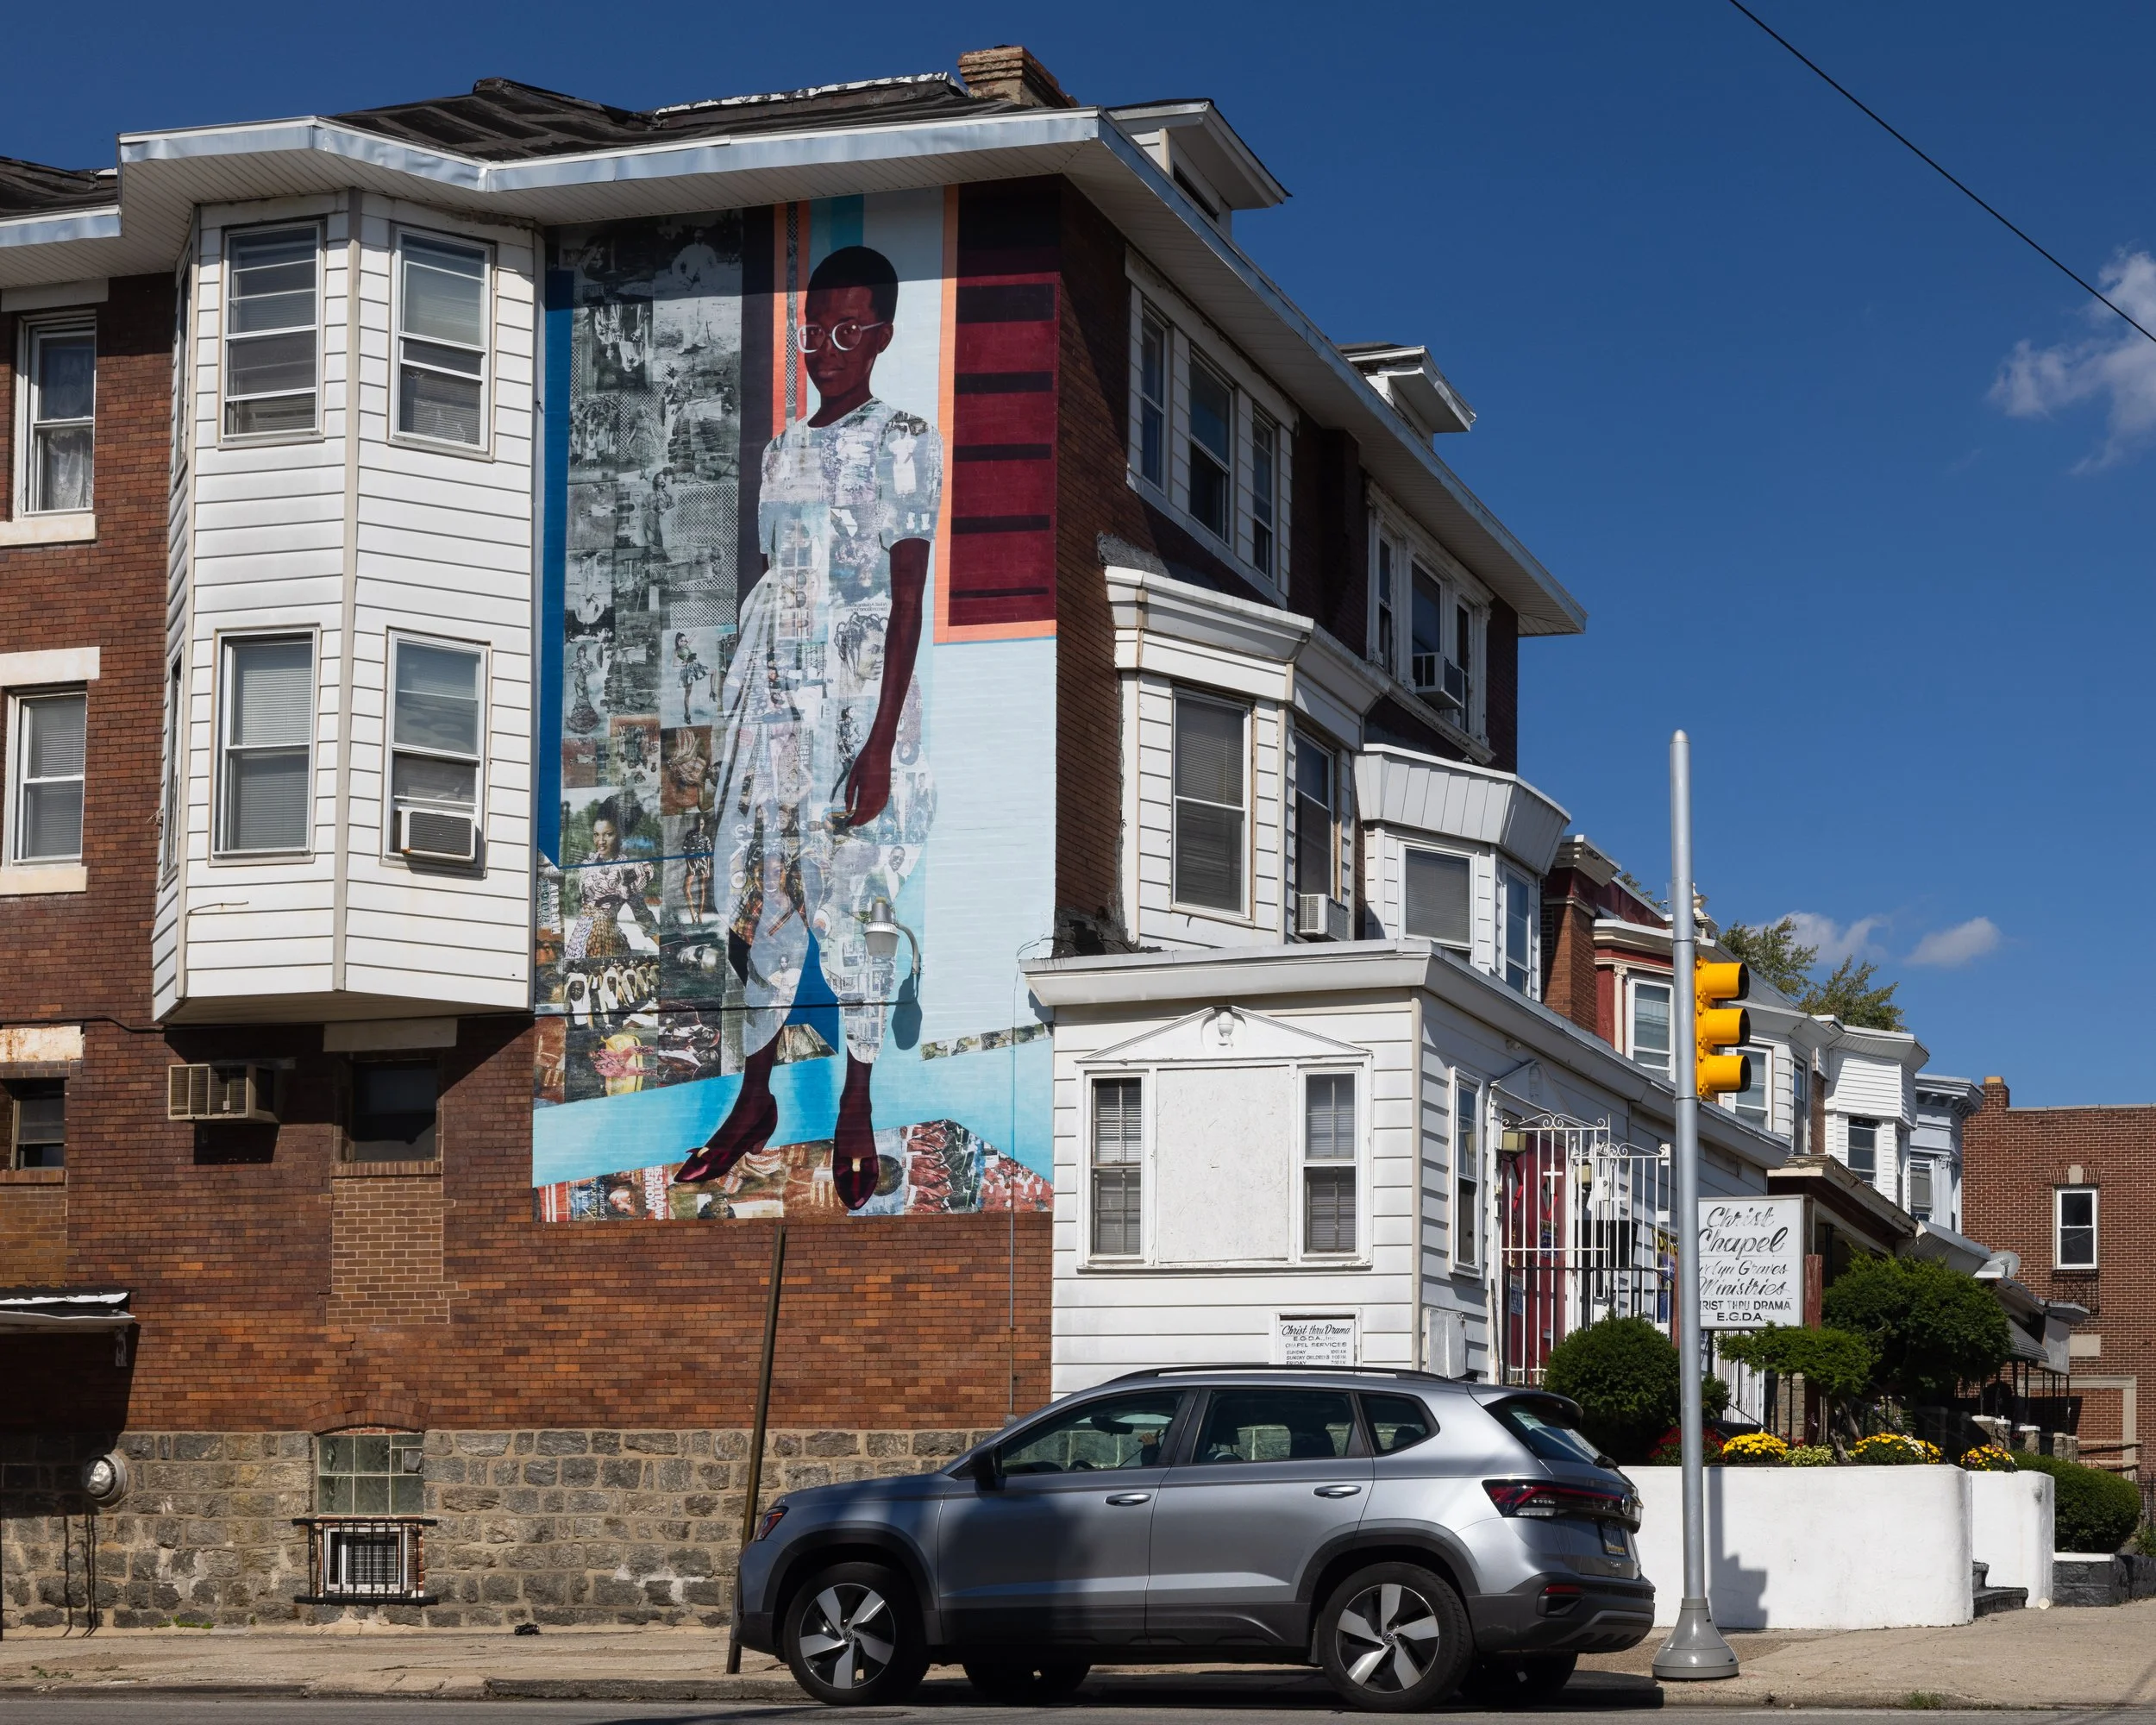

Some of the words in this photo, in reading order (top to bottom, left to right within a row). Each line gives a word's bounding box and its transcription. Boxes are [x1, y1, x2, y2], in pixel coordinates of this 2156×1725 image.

[1706, 1207, 1774, 1228] Christ
[1698, 1226, 1788, 1260] Chapel
[1739, 1260, 1790, 1275] Graves
[1699, 1276, 1791, 1295] Ministries
[1700, 1300, 1724, 1310] RIST
[1754, 1300, 1791, 1310] DRAMA
[1717, 1312, 1766, 1321] E.G.D.A.
